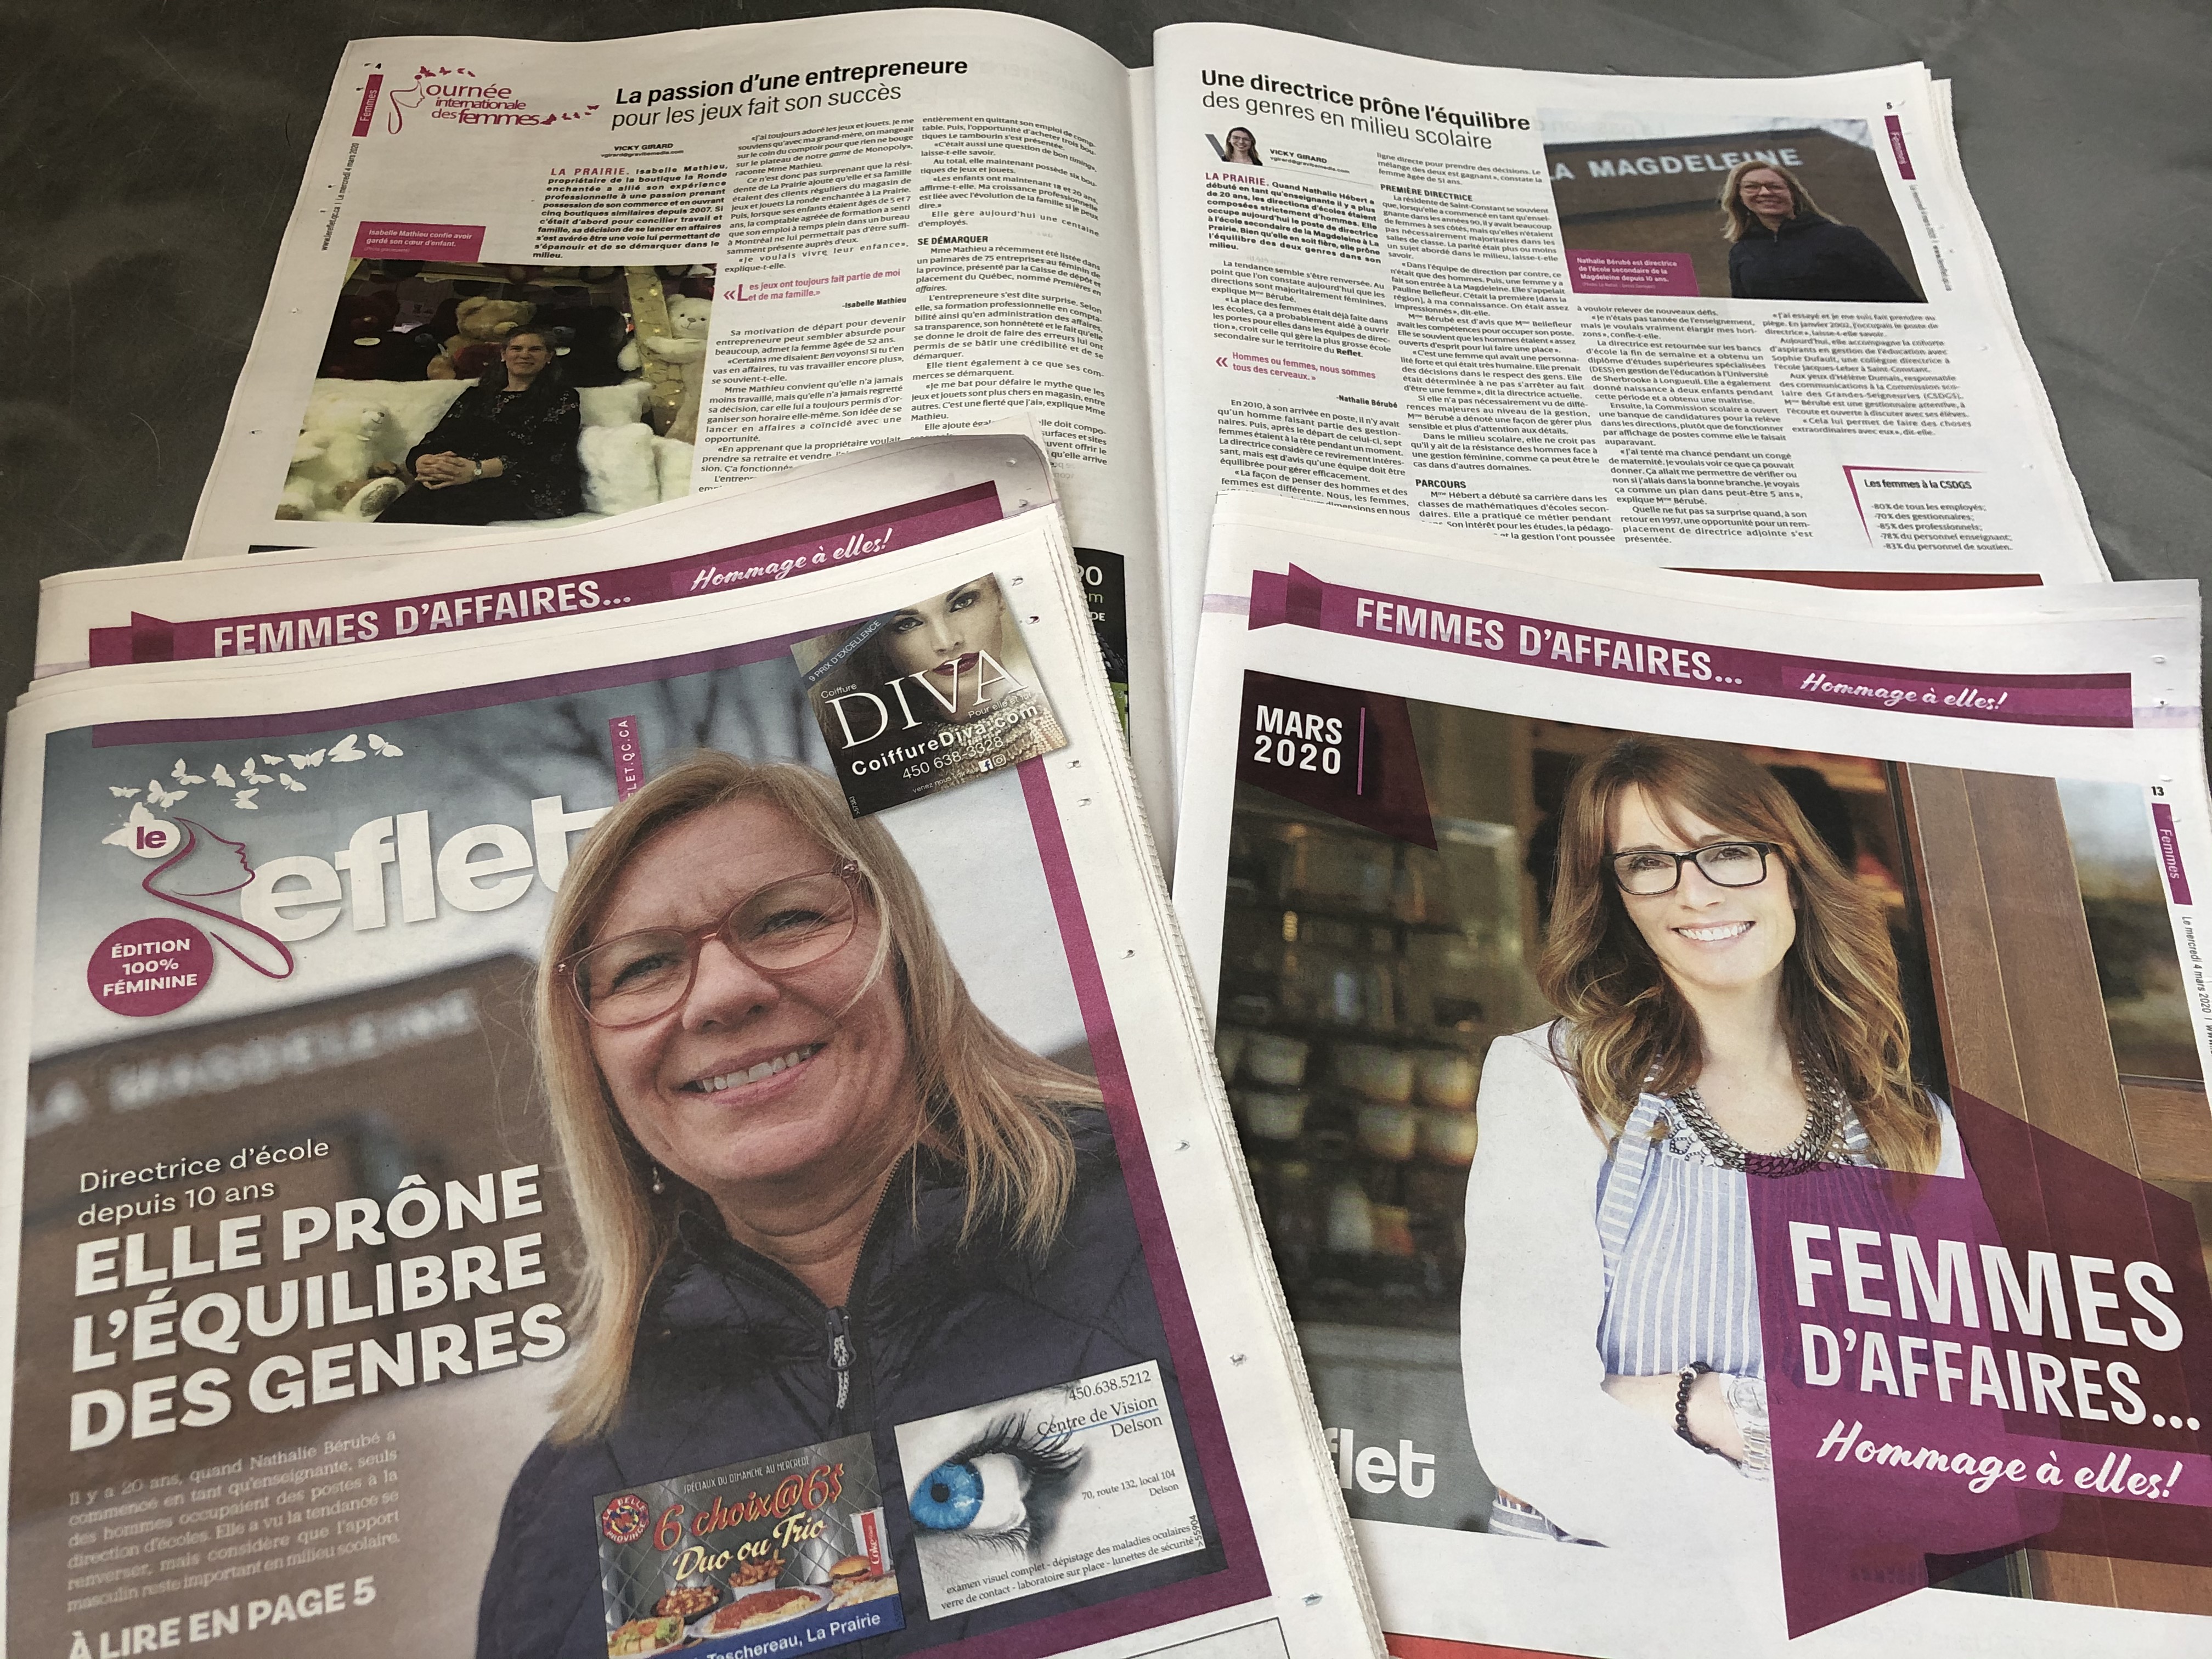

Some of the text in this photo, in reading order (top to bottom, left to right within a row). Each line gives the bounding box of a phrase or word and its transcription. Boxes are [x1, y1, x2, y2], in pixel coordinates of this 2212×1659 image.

[616, 61, 967, 106] La passion d'une entrepreneure
[1202, 70, 1530, 129] Une directrice prône l'équilibre
[360, 89, 377, 122] Femmes
[431, 108, 540, 126] des femmes
[435, 98, 527, 110] internationale
[611, 83, 900, 130] pour les jeux fait son succès
[1203, 91, 1491, 149] des genres en milieu scolaire
[1296, 154, 1327, 163] GIRARD
[1588, 148, 1803, 179] MAGDELEINE
[1223, 173, 1268, 185] PRAIRIE.
[1380, 184, 1472, 201] PREMIÈRE DIRECTRICE
[932, 235, 988, 245] DÉMARQUER
[1233, 352, 1268, 363] Hommes
[1283, 358, 1317, 371] femmes,
[1341, 369, 1375, 379] sommes
[1233, 363, 1250, 371] tous
[1270, 369, 1309, 380] cerveaux.
[1336, 395, 1397, 408] -Nathalie Bérubé
[1415, 478, 1466, 489] PARCOURS
[1864, 479, 1972, 489] Les femmes à la CSDGS
[213, 610, 379, 658] FEMMES
[691, 557, 806, 591] Hommage
[809, 544, 827, 566] à
[832, 527, 893, 558] elles!
[814, 662, 833, 678] PRIX
[1356, 597, 1504, 651] FEMMES
[1800, 672, 1917, 707] Hommage
[1922, 686, 1938, 705] à
[1944, 690, 2008, 710] elles!
[821, 683, 857, 698] Coiffure
[825, 650, 1029, 750] DIVA
[1256, 705, 1343, 745] MARS
[618, 720, 637, 797] LET.QC.CA
[902, 736, 1003, 780] 450 638-3328
[1254, 735, 1342, 775] 2020
[2151, 786, 2165, 797] 13
[136, 825, 168, 850] le
[2159, 827, 2180, 879] Femmes
[2181, 916, 2193, 926] Le
[111, 938, 191, 958] ÉDITION
[2185, 927, 2203, 963] mercredi
[122, 957, 179, 975] 100%
[2196, 970, 2205, 992] mars
[103, 971, 198, 998] FÉMININE
[2199, 994, 2211, 1013] 2020
[78, 1154, 222, 1194] Directrice
[77, 1180, 276, 1227] depuis 10 ans
[75, 1164, 542, 1296] ELLE PRÔNE
[1788, 1221, 2183, 1352] FEMMES
[70, 1302, 567, 1452] DES GENRES
[1069, 1369, 1152, 1402] 450.638.5212
[1037, 1397, 1158, 1436] Centre de Vision
[1111, 1414, 1163, 1438] Delson
[684, 1455, 810, 1494] SPÉCIAUX DU DIMANCHE AU MERCREDI
[1815, 1419, 2183, 1499] Hommage à elles!
[1082, 1469, 1176, 1500] 70, route 132, local 104
[1149, 1483, 1180, 1498] Delson
[653, 1504, 684, 1551] 6
[672, 1545, 734, 1581] Duo
[737, 1539, 774, 1562] ou
[773, 1511, 828, 1548] Trio
[946, 1525, 1191, 1594] examen visuel complet dépistage des maladies oculaires
[69, 1575, 377, 1659] À LIRE EN PAGE 5
[806, 1627, 826, 1643] La
[829, 1612, 882, 1637] Prairie
